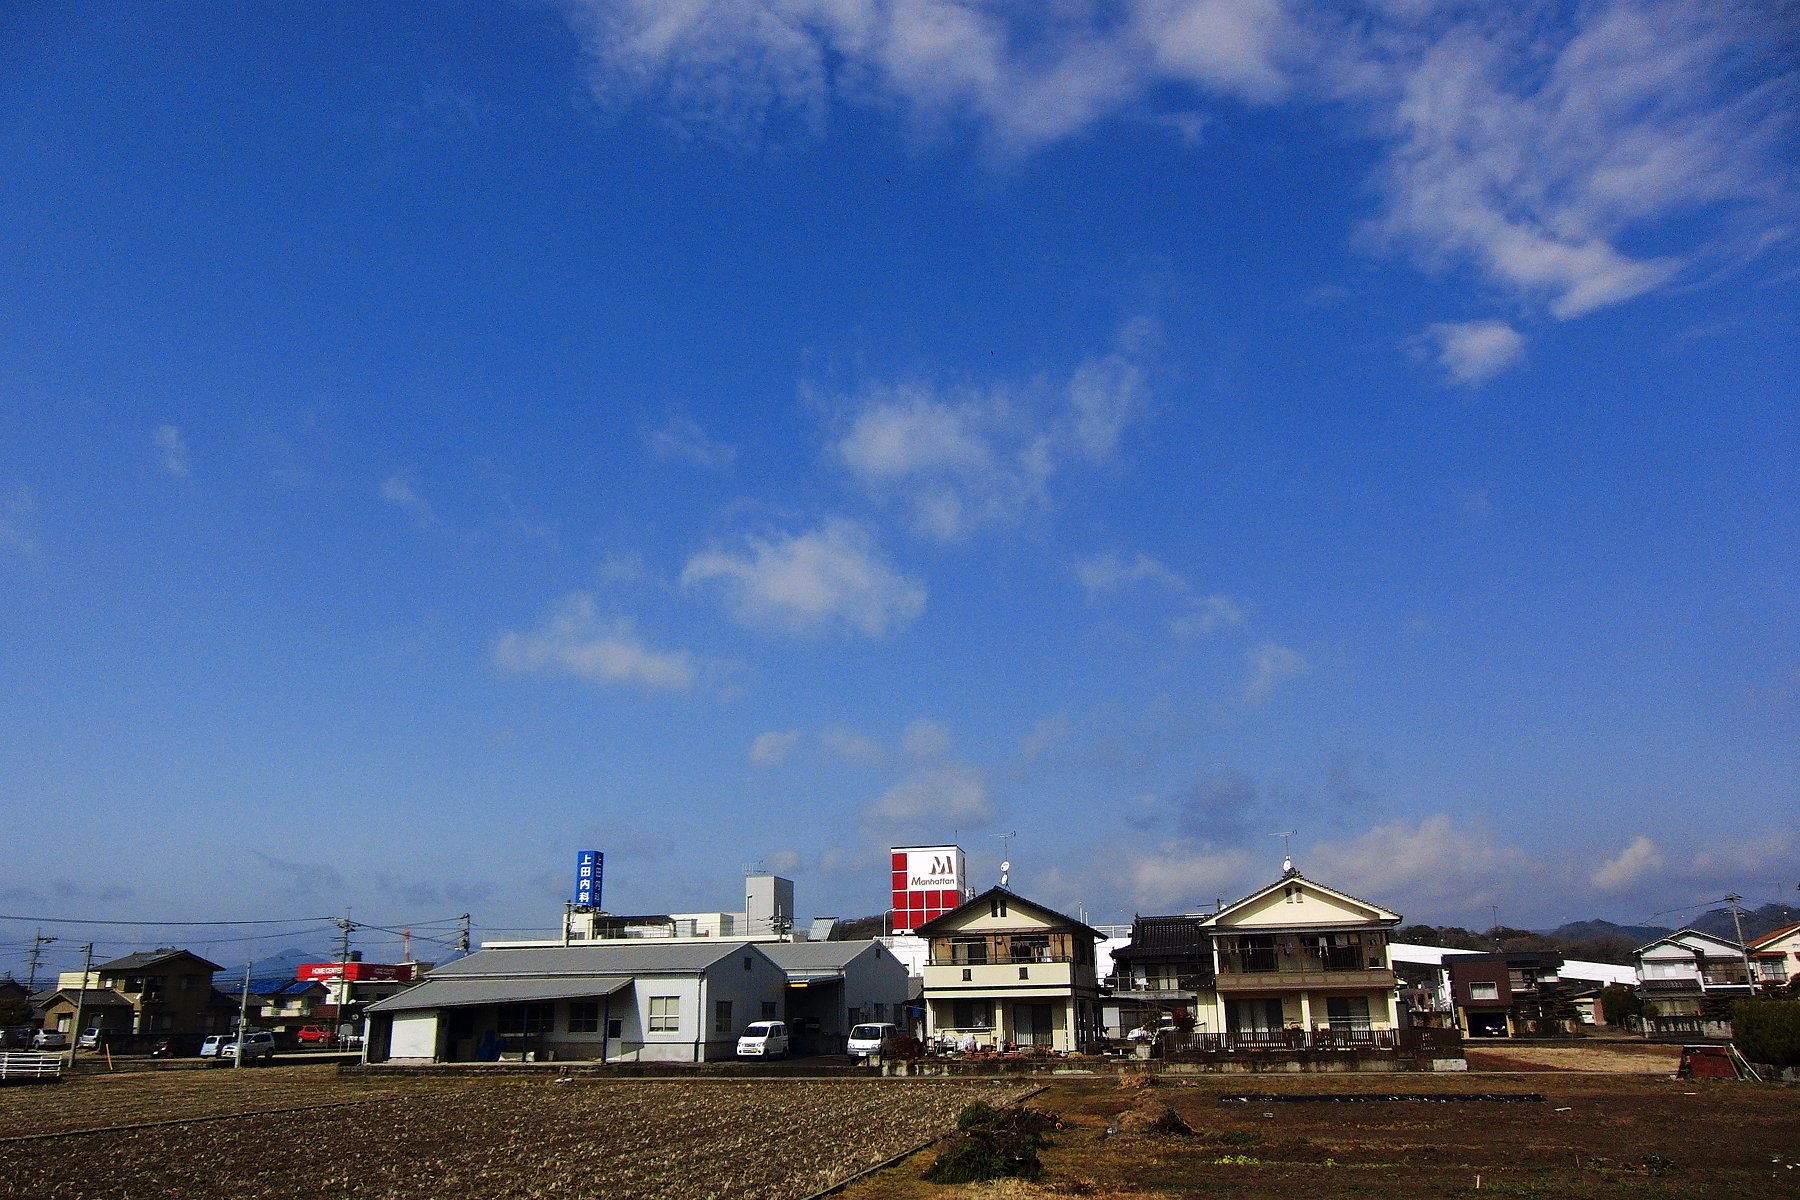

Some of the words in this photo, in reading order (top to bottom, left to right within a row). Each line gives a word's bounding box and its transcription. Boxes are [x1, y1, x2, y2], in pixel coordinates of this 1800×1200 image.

[579, 855, 591, 902] 上田内科
[911, 877, 954, 885] Manhattan
